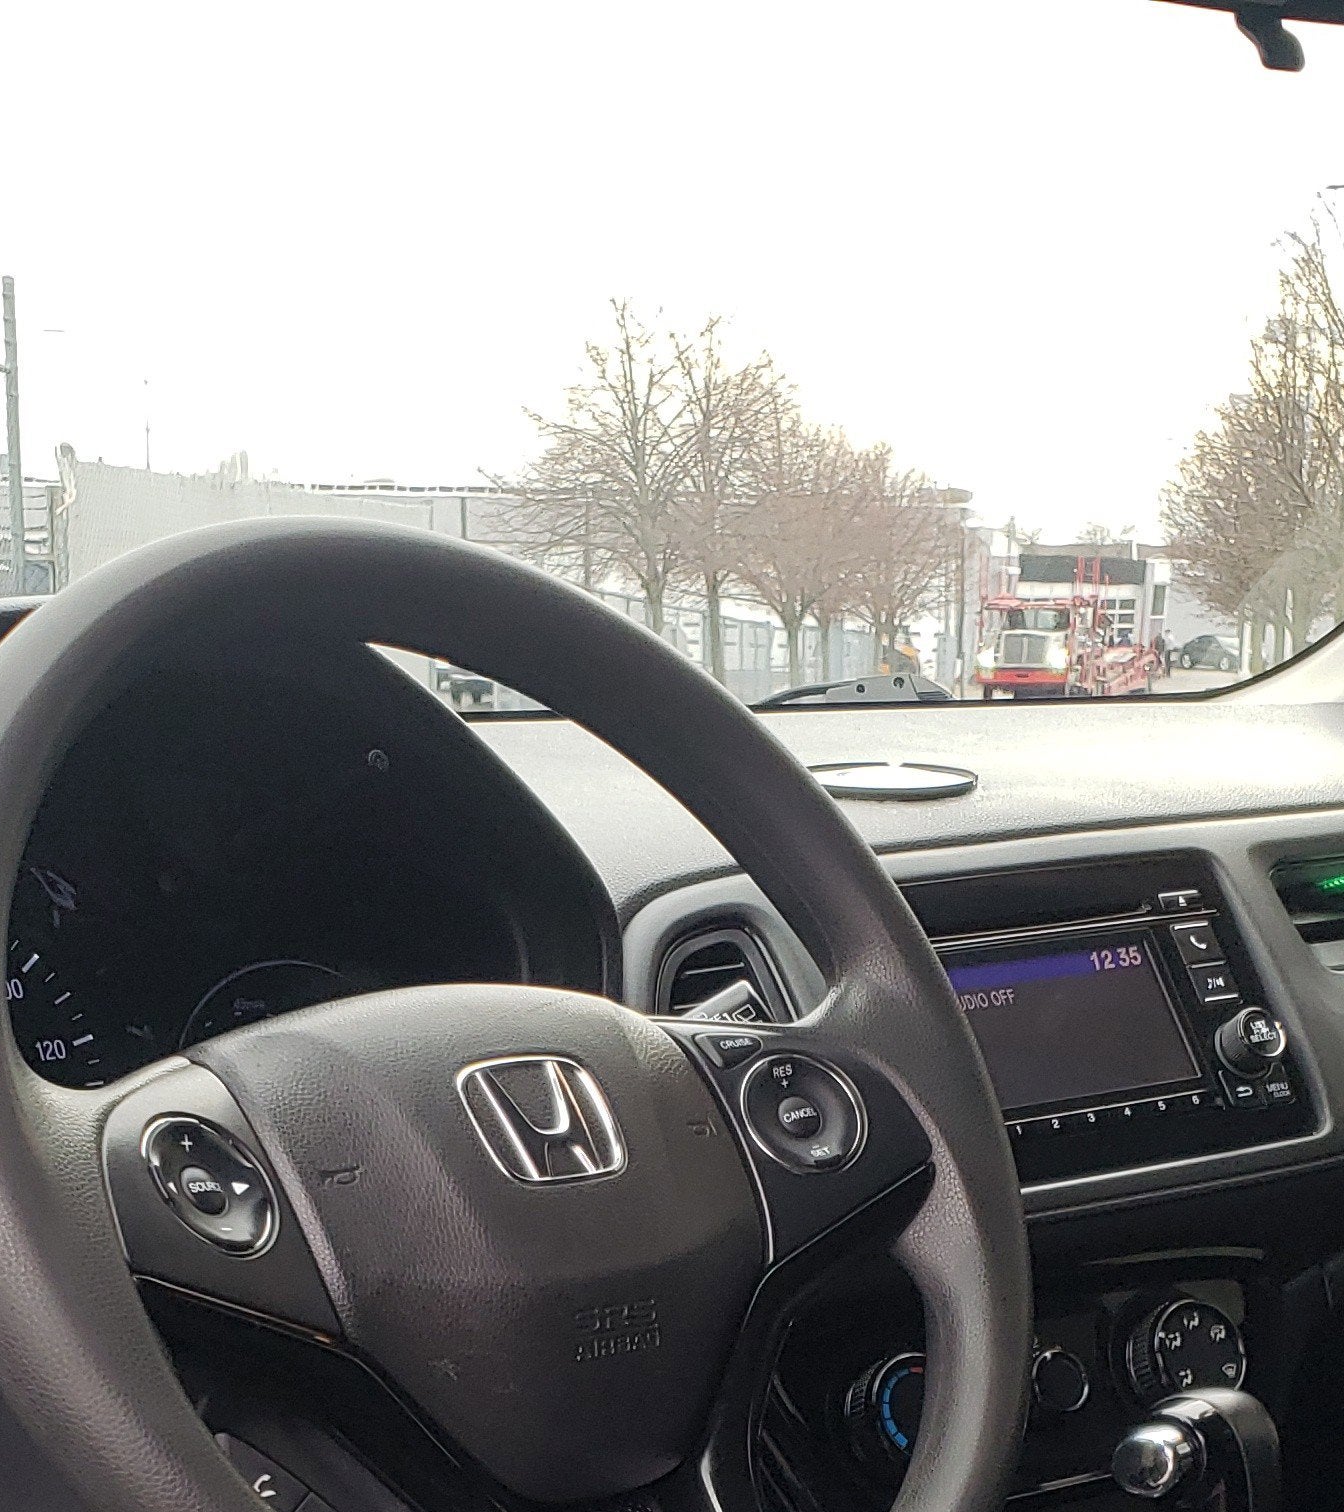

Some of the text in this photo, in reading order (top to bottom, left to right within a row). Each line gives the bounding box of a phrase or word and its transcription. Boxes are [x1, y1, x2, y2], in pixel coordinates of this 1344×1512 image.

[957, 989, 1015, 1012] UDIO OFF
[719, 1038, 754, 1050] CRUISE
[36, 1040, 66, 1061] 120
[772, 1064, 793, 1079] RES
[1266, 1081, 1289, 1092] MENU
[1192, 1095, 1200, 1105] 6
[1158, 1101, 1167, 1111] 5
[783, 1107, 818, 1124] CANCEL
[1124, 1107, 1131, 1117] 4
[1087, 1113, 1096, 1123] 3
[1051, 1119, 1060, 1129] 2
[1016, 1125, 1022, 1135] 1
[810, 1147, 831, 1158] SET
